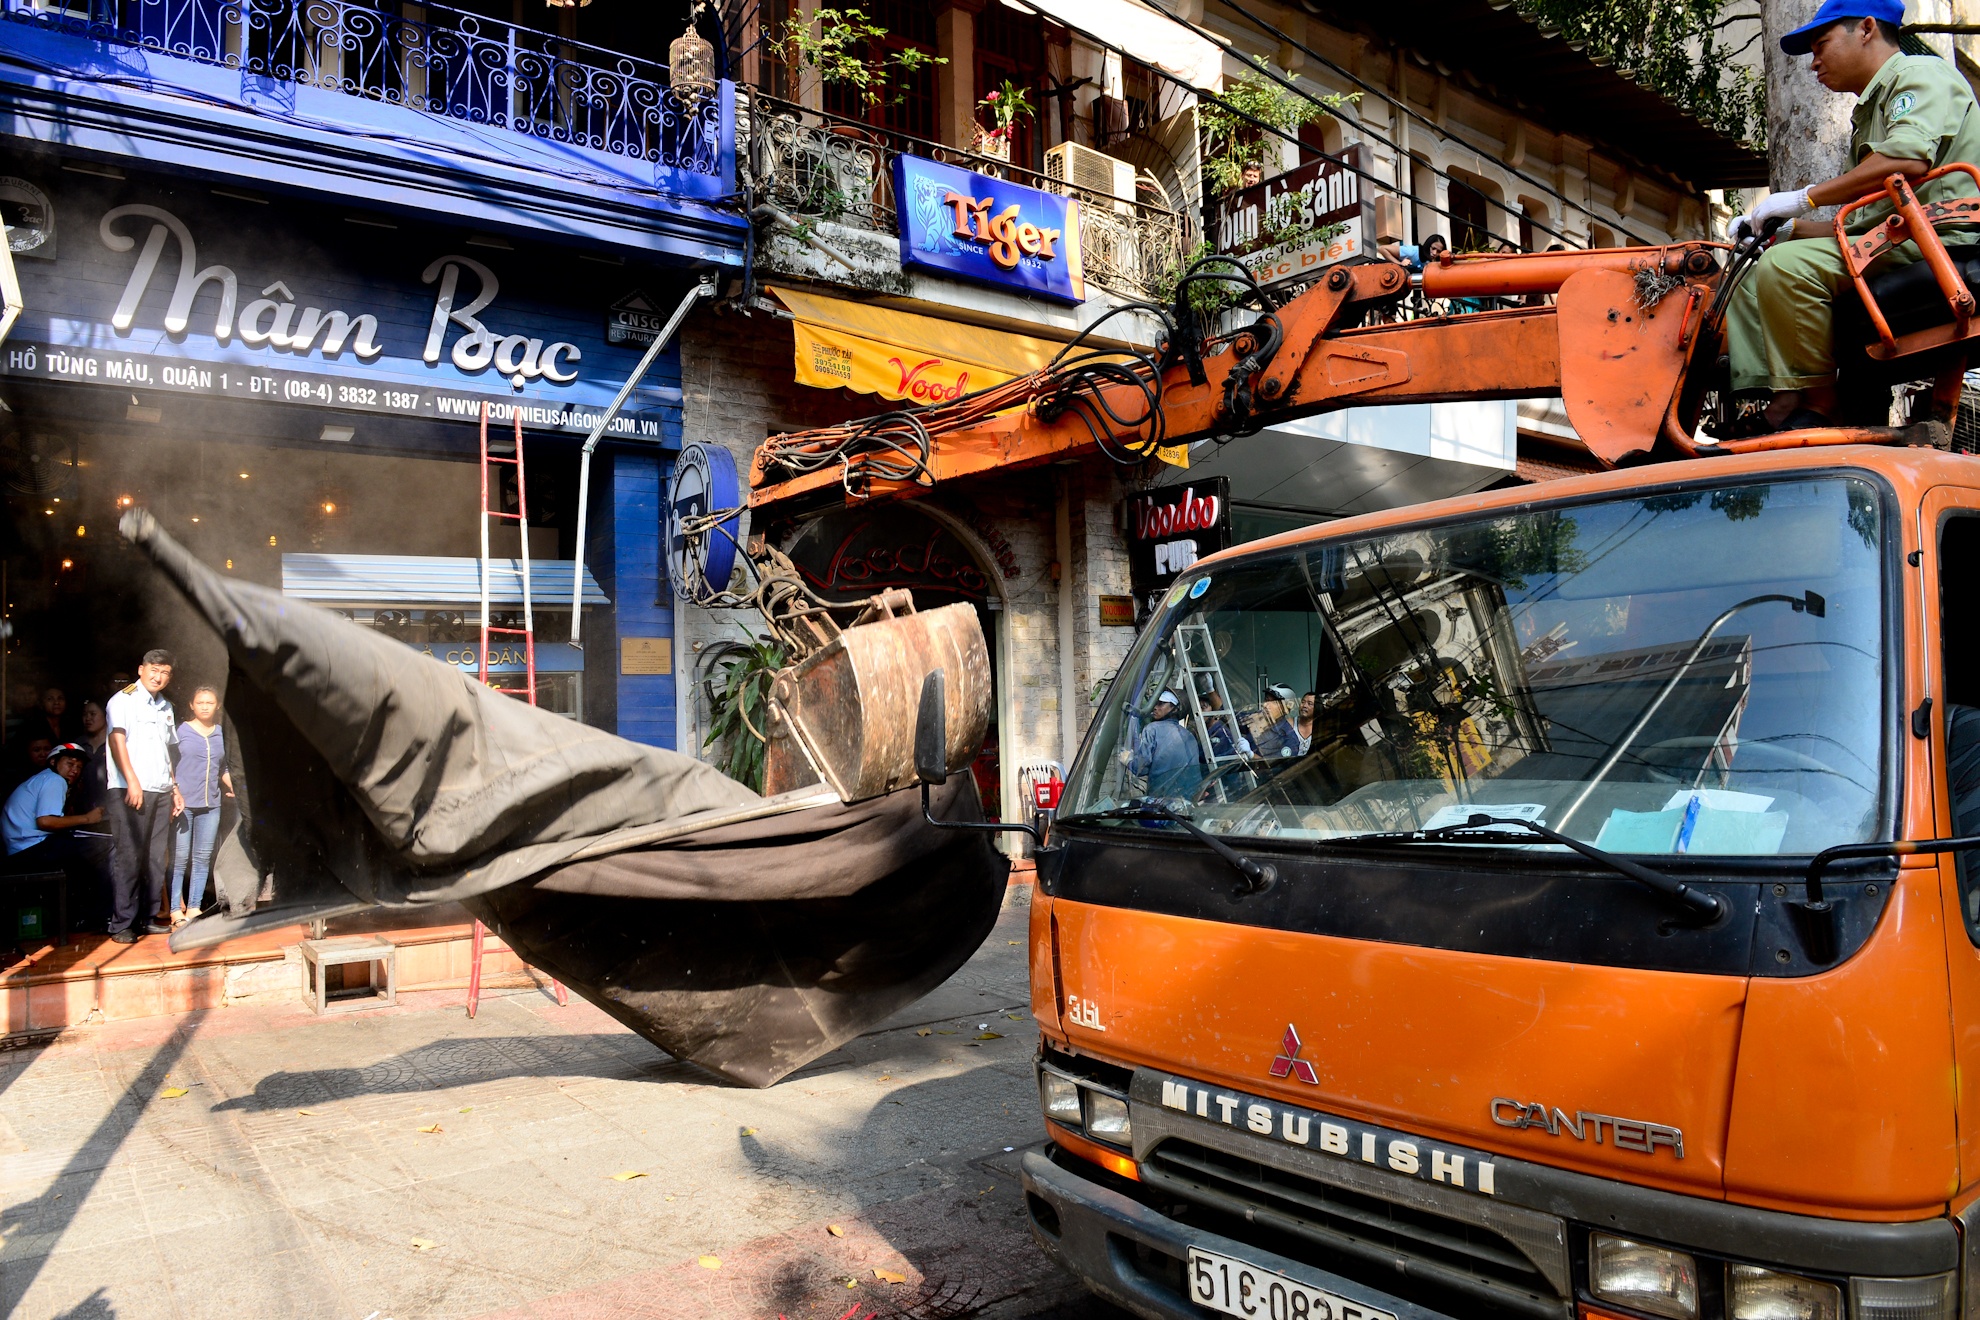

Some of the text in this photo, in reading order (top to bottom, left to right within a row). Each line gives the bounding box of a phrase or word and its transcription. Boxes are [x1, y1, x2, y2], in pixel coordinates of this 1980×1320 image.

[1219, 196, 1259, 251] bún
[1300, 154, 1358, 231] gánh
[944, 191, 1061, 271] Tiger
[958, 243, 984, 256] SINCE
[1021, 258, 1043, 270] 1932
[1301, 238, 1356, 268] biệt
[100, 203, 582, 388] Mâm Bạc
[611, 329, 659, 343] RESTAURA
[618, 312, 660, 330] CNSG
[9, 345, 37, 371] HỒ
[45, 350, 98, 377] TÙNG
[105, 360, 155, 386] MẬU,
[162, 365, 213, 389] QUẬN
[219, 374, 229, 390] 1
[250, 376, 278, 395] ĐT:
[284, 380, 333, 403] (08-4)
[338, 385, 377, 405] 3832
[383, 391, 419, 410] 1387
[436, 396, 658, 437] WWWCOMNIEUSAIGONCOM.VN
[888, 357, 971, 402] Vood
[673, 450, 706, 484] RESTAURANT
[1132, 487, 1219, 540] Voodoo
[1155, 539, 1199, 576] PUB
[446, 646, 476, 666] CÔ
[1161, 1080, 1496, 1196] MITSUBISHI
[1489, 1096, 1685, 1160] CANTER
